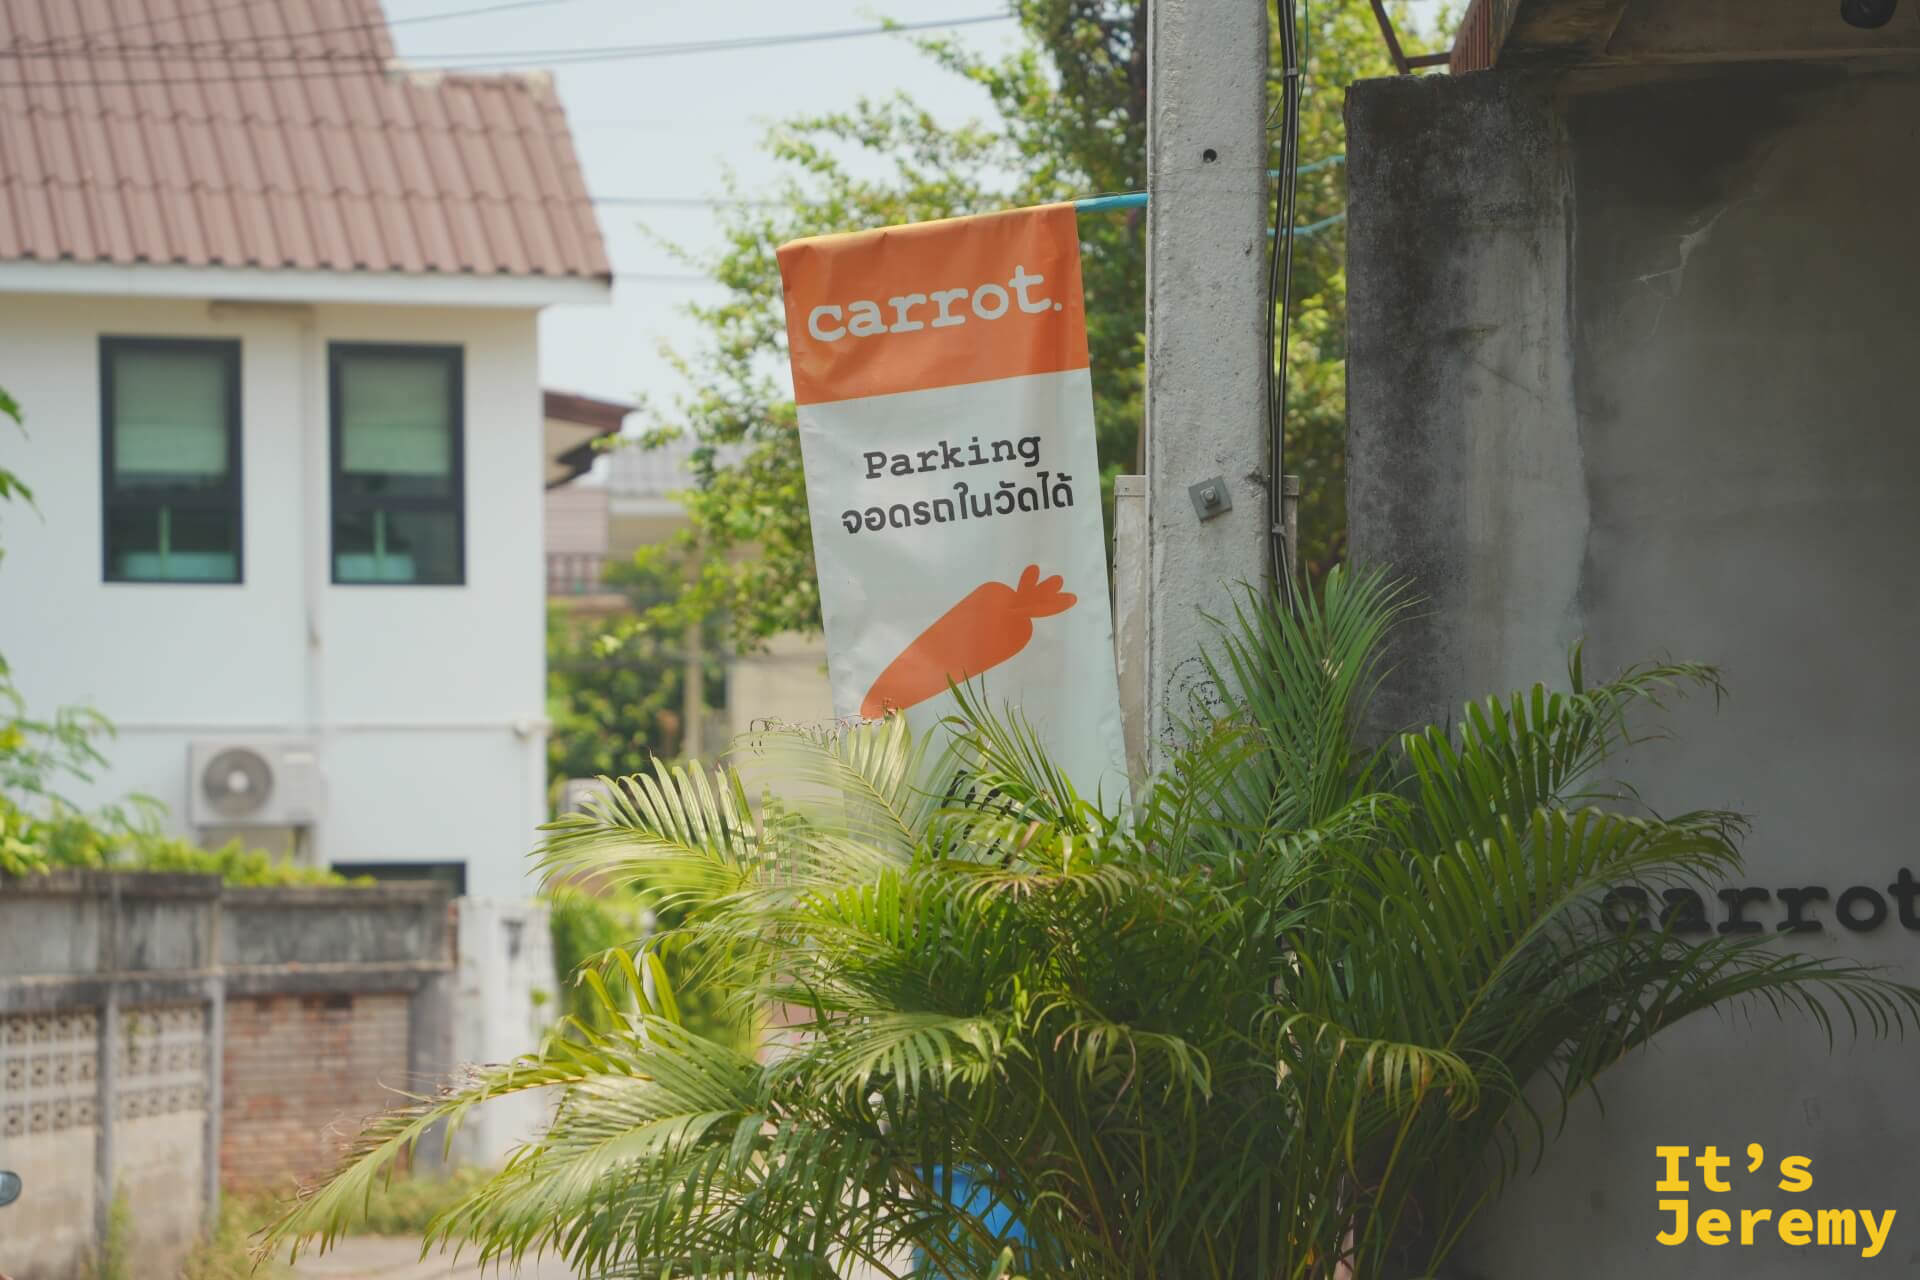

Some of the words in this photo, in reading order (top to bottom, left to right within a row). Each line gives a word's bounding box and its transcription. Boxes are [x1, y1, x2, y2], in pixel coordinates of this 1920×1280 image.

[807, 264, 1063, 342] carrot.
[863, 435, 1041, 479] Parking
[841, 471, 1074, 534] จอดรถในวัดได้
